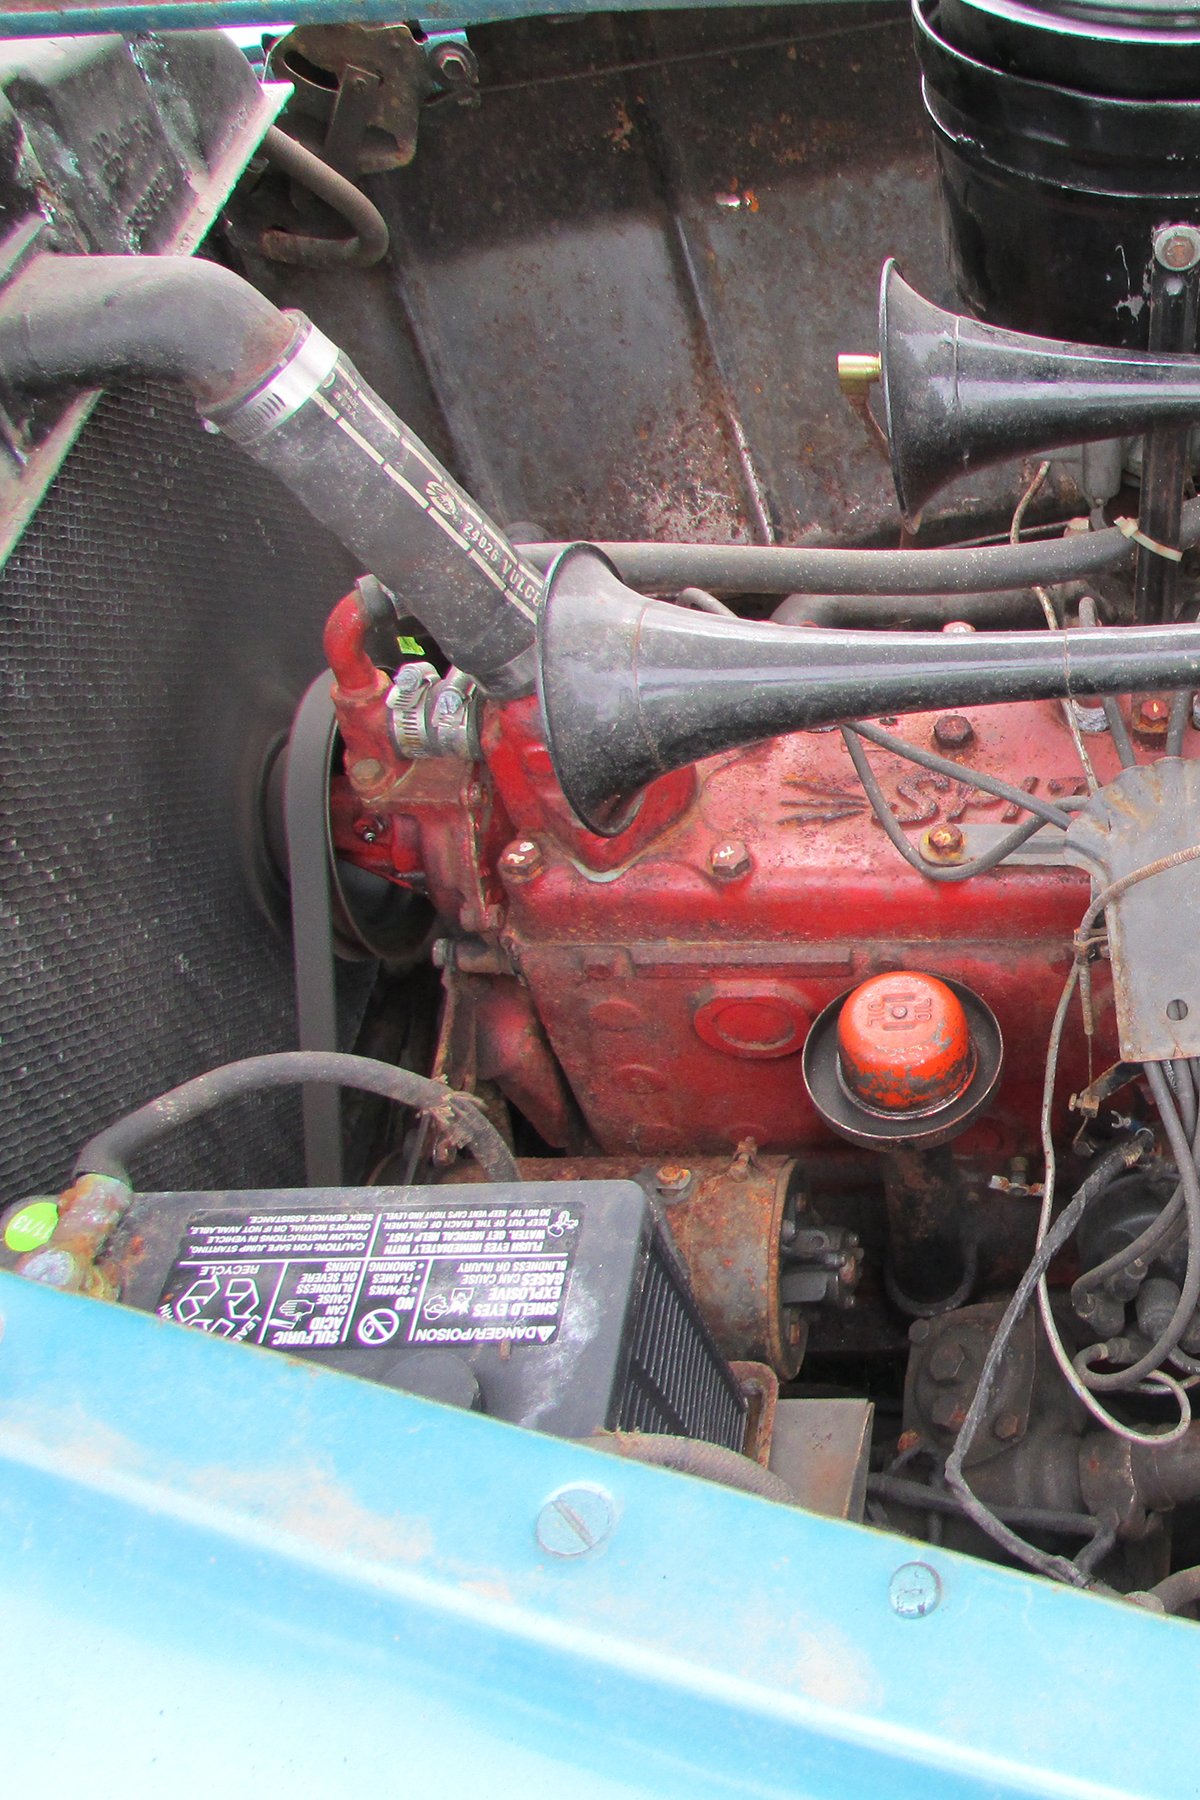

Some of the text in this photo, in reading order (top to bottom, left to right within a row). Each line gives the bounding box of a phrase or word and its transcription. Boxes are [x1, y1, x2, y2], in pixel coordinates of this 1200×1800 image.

[463, 522, 500, 562] 24026
[866, 1001, 885, 1027] OIL
[915, 997, 933, 1021] OIL
[249, 1213, 373, 1223] SEEK SERVICE ASSISTANCE.
[411, 1211, 426, 1219] AND
[427, 1211, 446, 1219] TIGHT
[447, 1210, 468, 1218] CAPS
[469, 1210, 488, 1218] VENT
[489, 1209, 507, 1217] KEEP
[523, 1209, 539, 1217] NOT
[540, 1208, 551, 1217] DO
[190, 1222, 371, 1234] OWNER'S MANUAL OR IF NOT AVAILABLE,
[382, 1218, 549, 1229] KEEP OUT OF THE REACH OF CHILDREN.
[207, 1232, 368, 1243] FOLLOW INSTRUCTIONS IN VEHICLE
[386, 1229, 546, 1242] WATER. GET MEDICAL HELP FAST.
[189, 1242, 365, 1253] CAUTION: FOR SAFE JUMP STARTING,
[384, 1241, 543, 1254] FLUSH EYES IMMEDIATELY WITH
[199, 1264, 260, 1275] RECYCLE
[325, 1261, 361, 1272] BURNS
[368, 1261, 416, 1272] SMOKING
[456, 1260, 567, 1272] BLINDNESS OR INJURY
[298, 1272, 358, 1283] OR SEVERE
[372, 1273, 413, 1284] FLAMES
[461, 1272, 564, 1285] GASES CAN CAUSE
[296, 1283, 355, 1293] BLINDNESS
[369, 1285, 410, 1295] SPARKS
[488, 1286, 562, 1301] EXPLOSIVE
[316, 1294, 351, 1304] CAUSE
[394, 1296, 415, 1310] NO
[325, 1305, 348, 1315] CAN
[472, 1301, 558, 1317] SHIELD EYES
[309, 1316, 345, 1330] ACID
[271, 1330, 340, 1345] SULFURIC
[415, 1326, 538, 1341] DANGER/POISON
